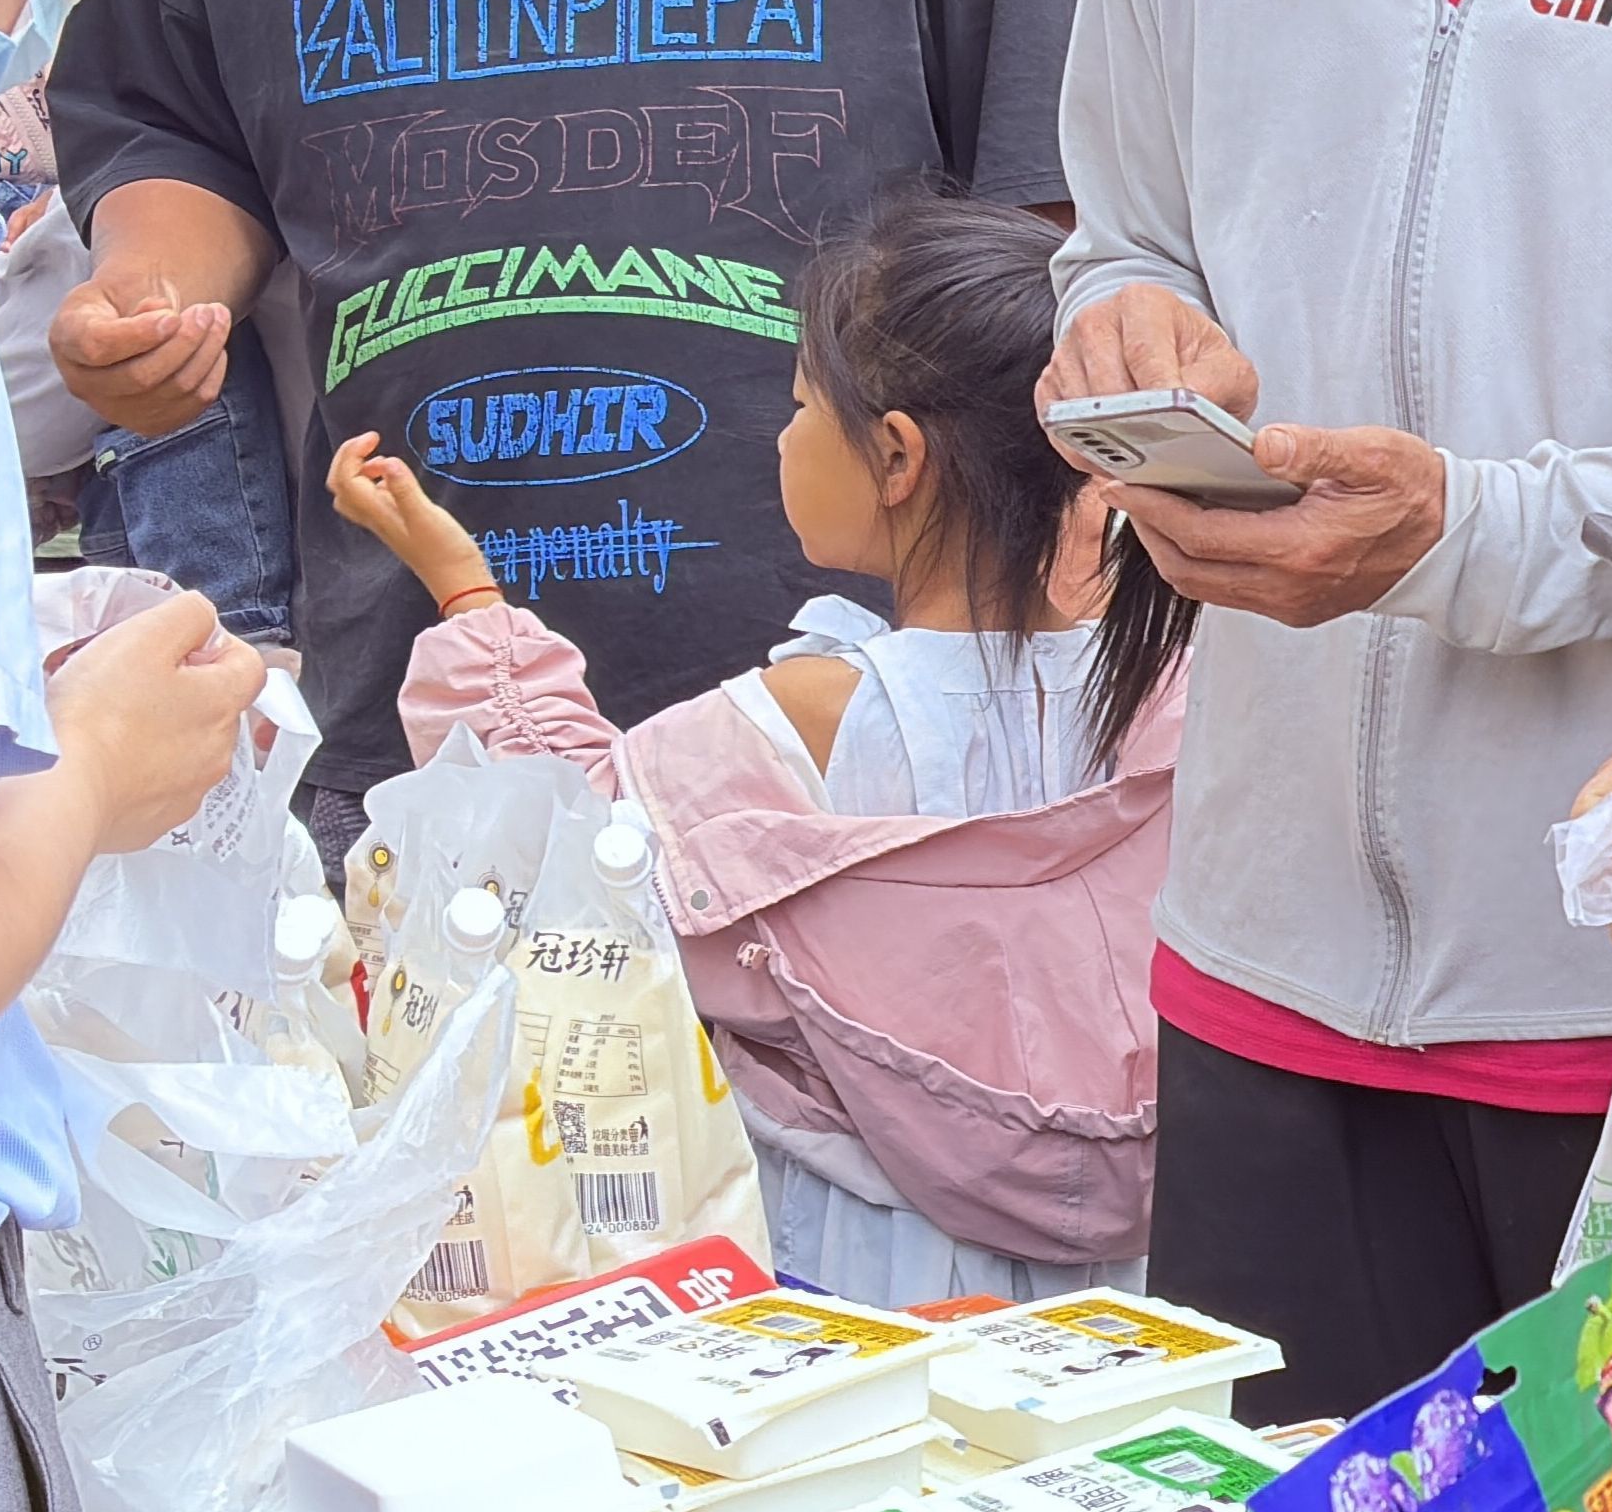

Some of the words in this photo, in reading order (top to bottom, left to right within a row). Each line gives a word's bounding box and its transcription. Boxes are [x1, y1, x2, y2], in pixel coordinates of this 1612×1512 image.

[426, 384, 673, 466] SUDHIR
[527, 931, 630, 982] 冠珍轩
